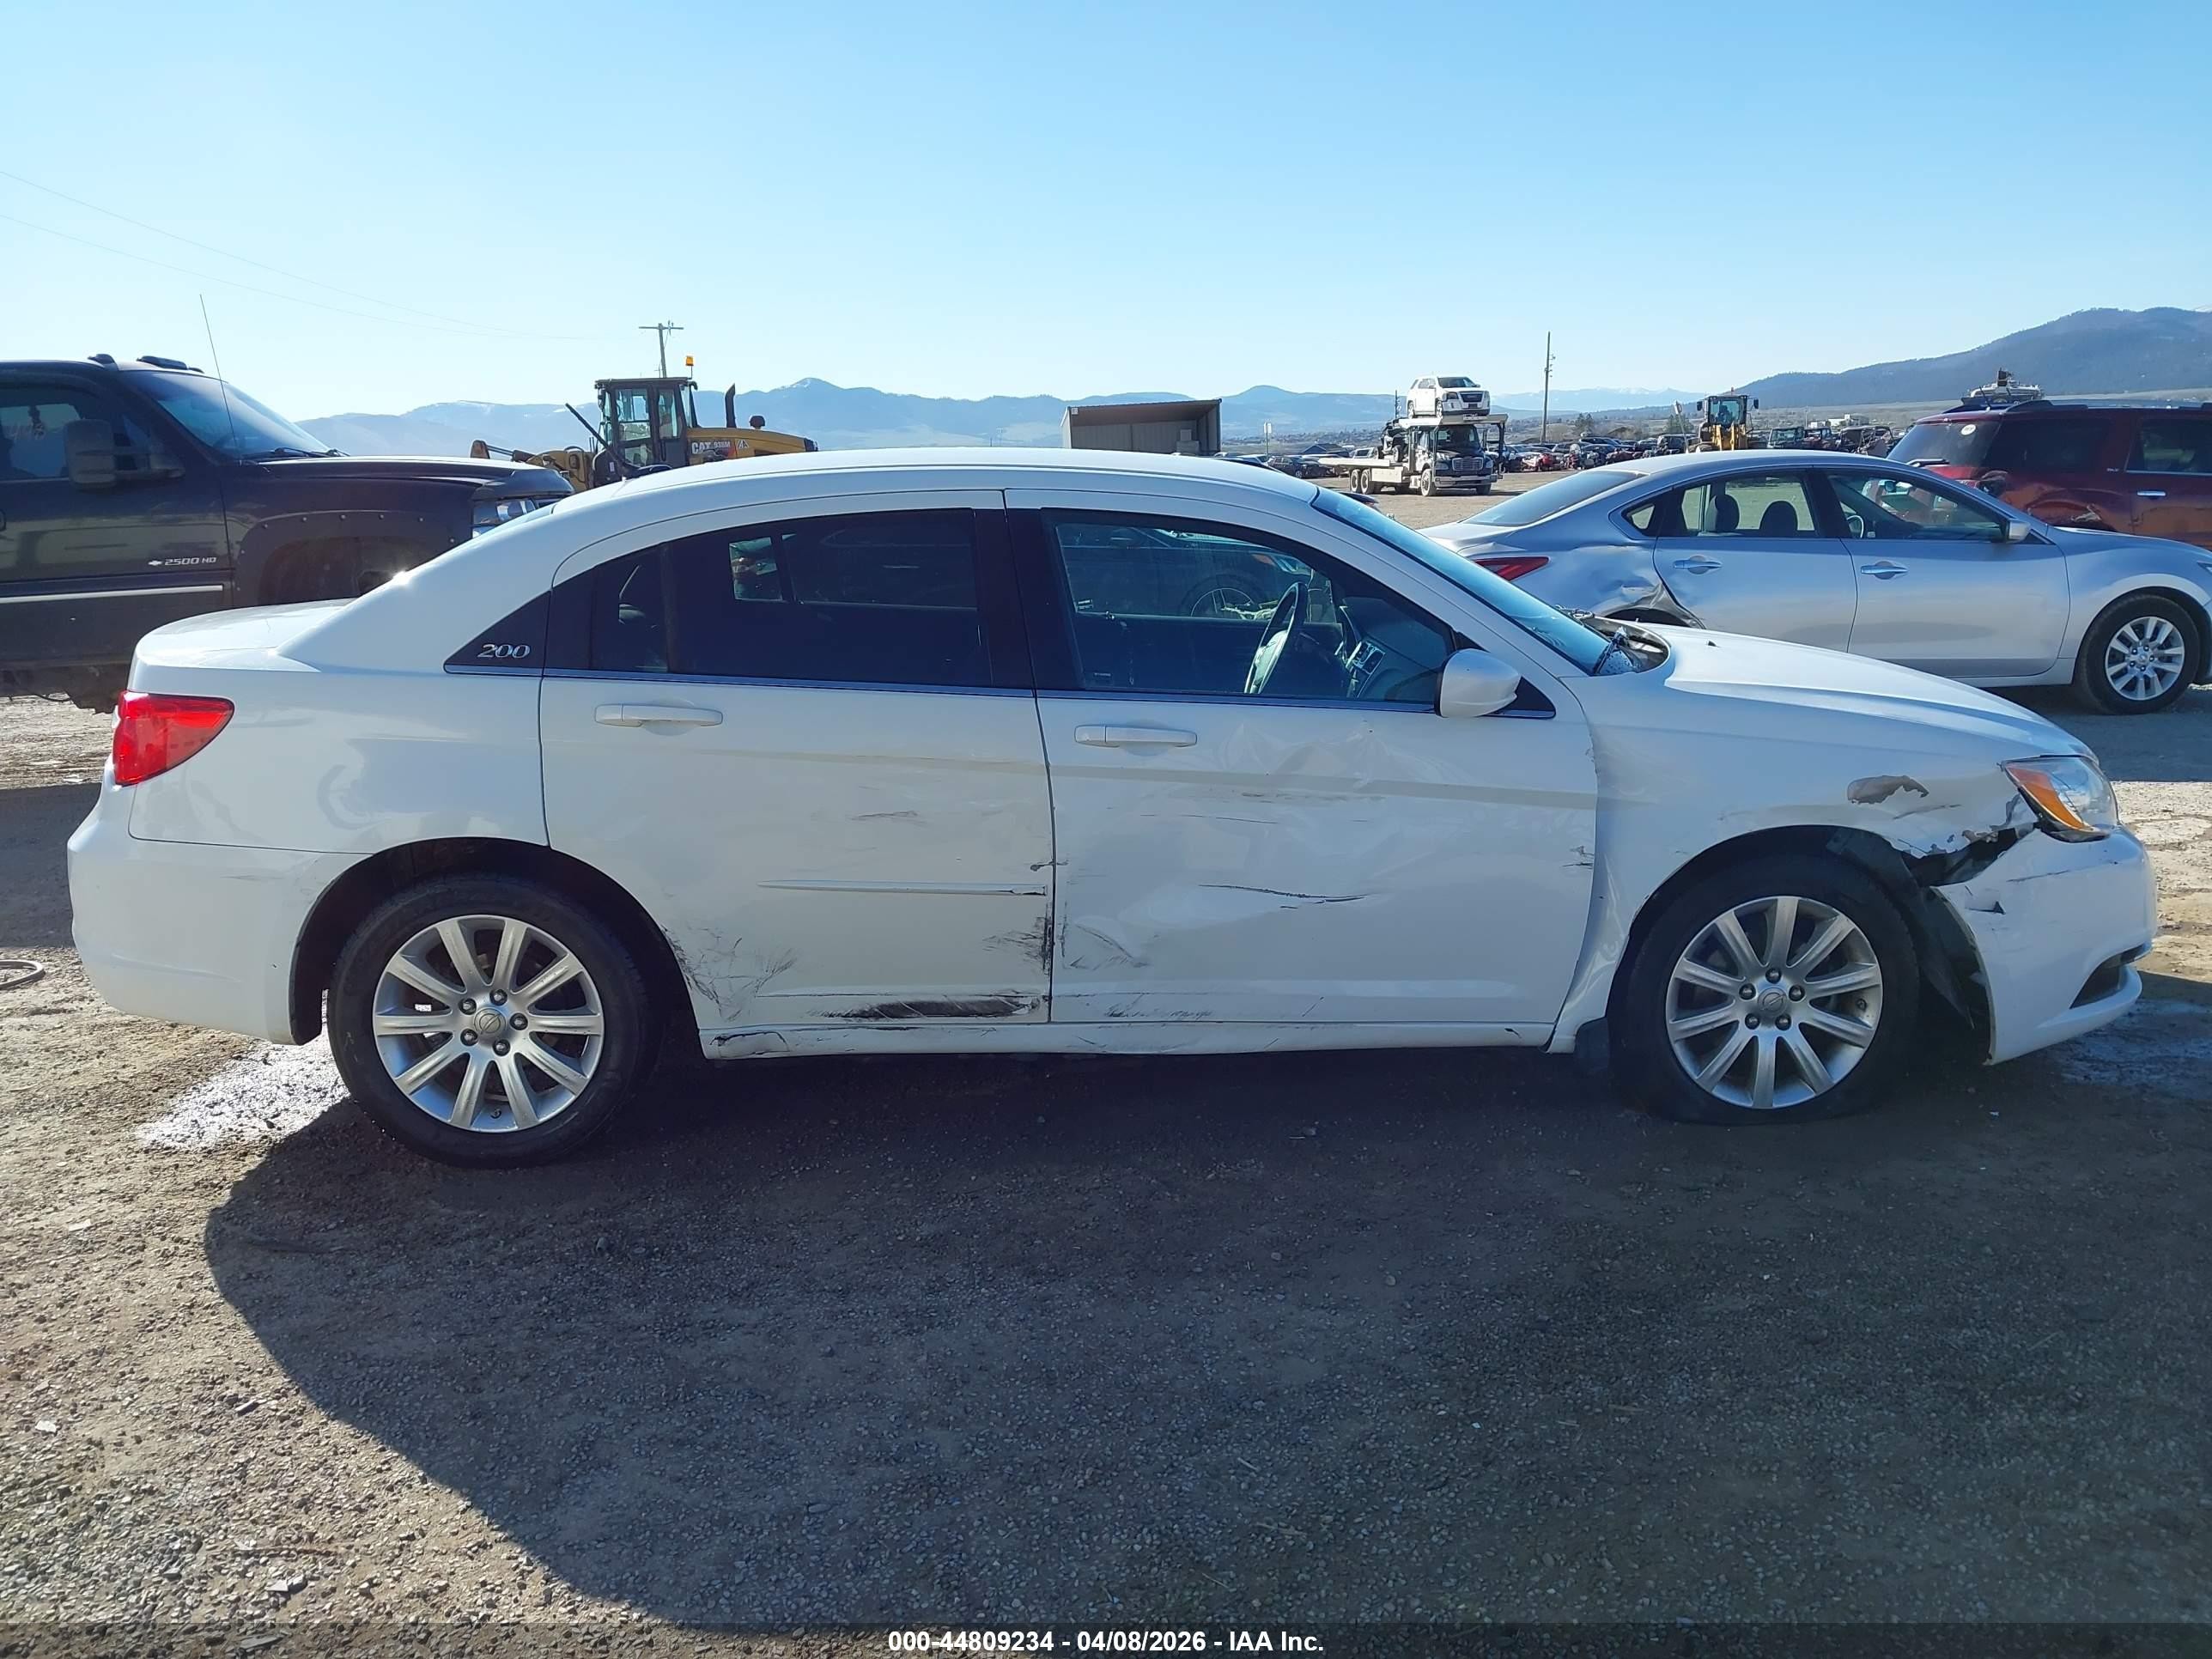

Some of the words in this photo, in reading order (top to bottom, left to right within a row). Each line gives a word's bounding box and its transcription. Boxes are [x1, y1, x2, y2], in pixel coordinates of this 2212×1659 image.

[691, 441, 712, 455] CAT
[164, 556, 200, 566] 2500
[477, 643, 531, 659] 200
